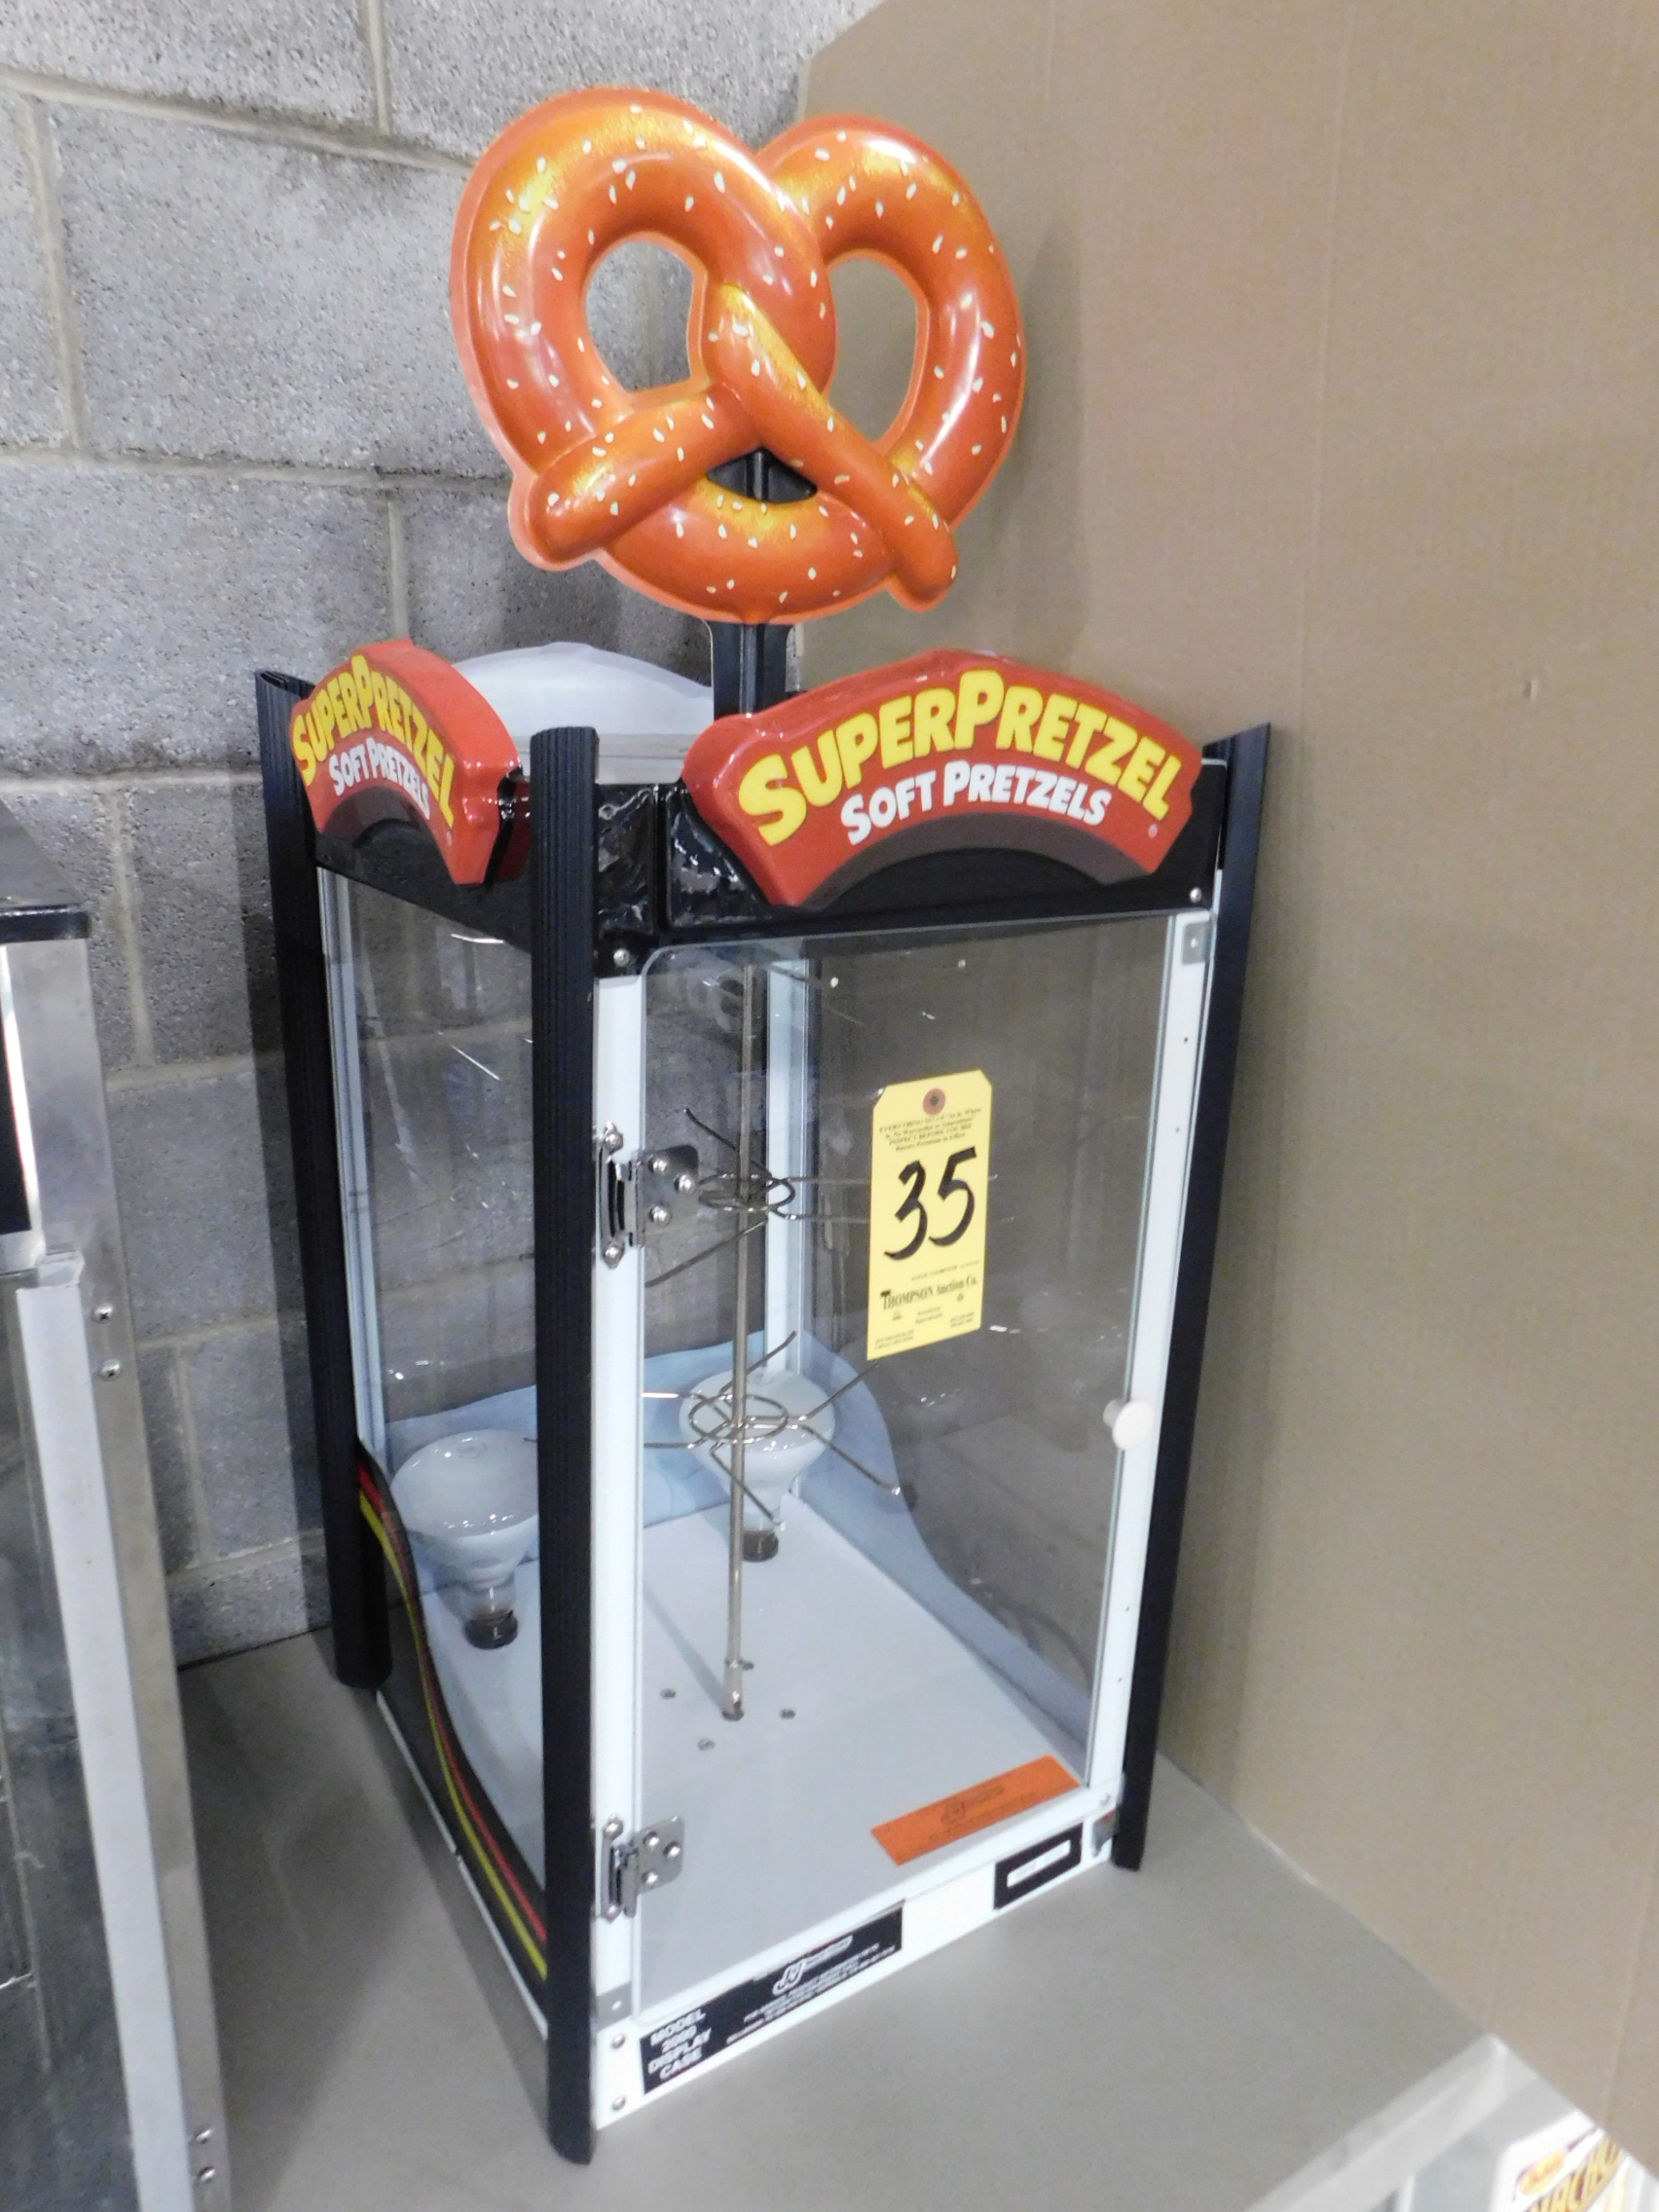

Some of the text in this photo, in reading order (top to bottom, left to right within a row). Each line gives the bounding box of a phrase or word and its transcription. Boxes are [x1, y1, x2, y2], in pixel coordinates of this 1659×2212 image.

[293, 654, 455, 830] SUPERPRETZEL
[328, 737, 430, 820] SOFT PRETZELS
[738, 669, 1182, 846] SUPERPRETZEL
[840, 758, 1112, 845] SOFT PRETZELS
[883, 1145, 977, 1261] 35
[879, 1285, 934, 1310] THOMPSON
[647, 2027, 712, 2076] DISPLAY
[649, 2008, 707, 2046] MODEL
[659, 2046, 703, 2081] CASE
